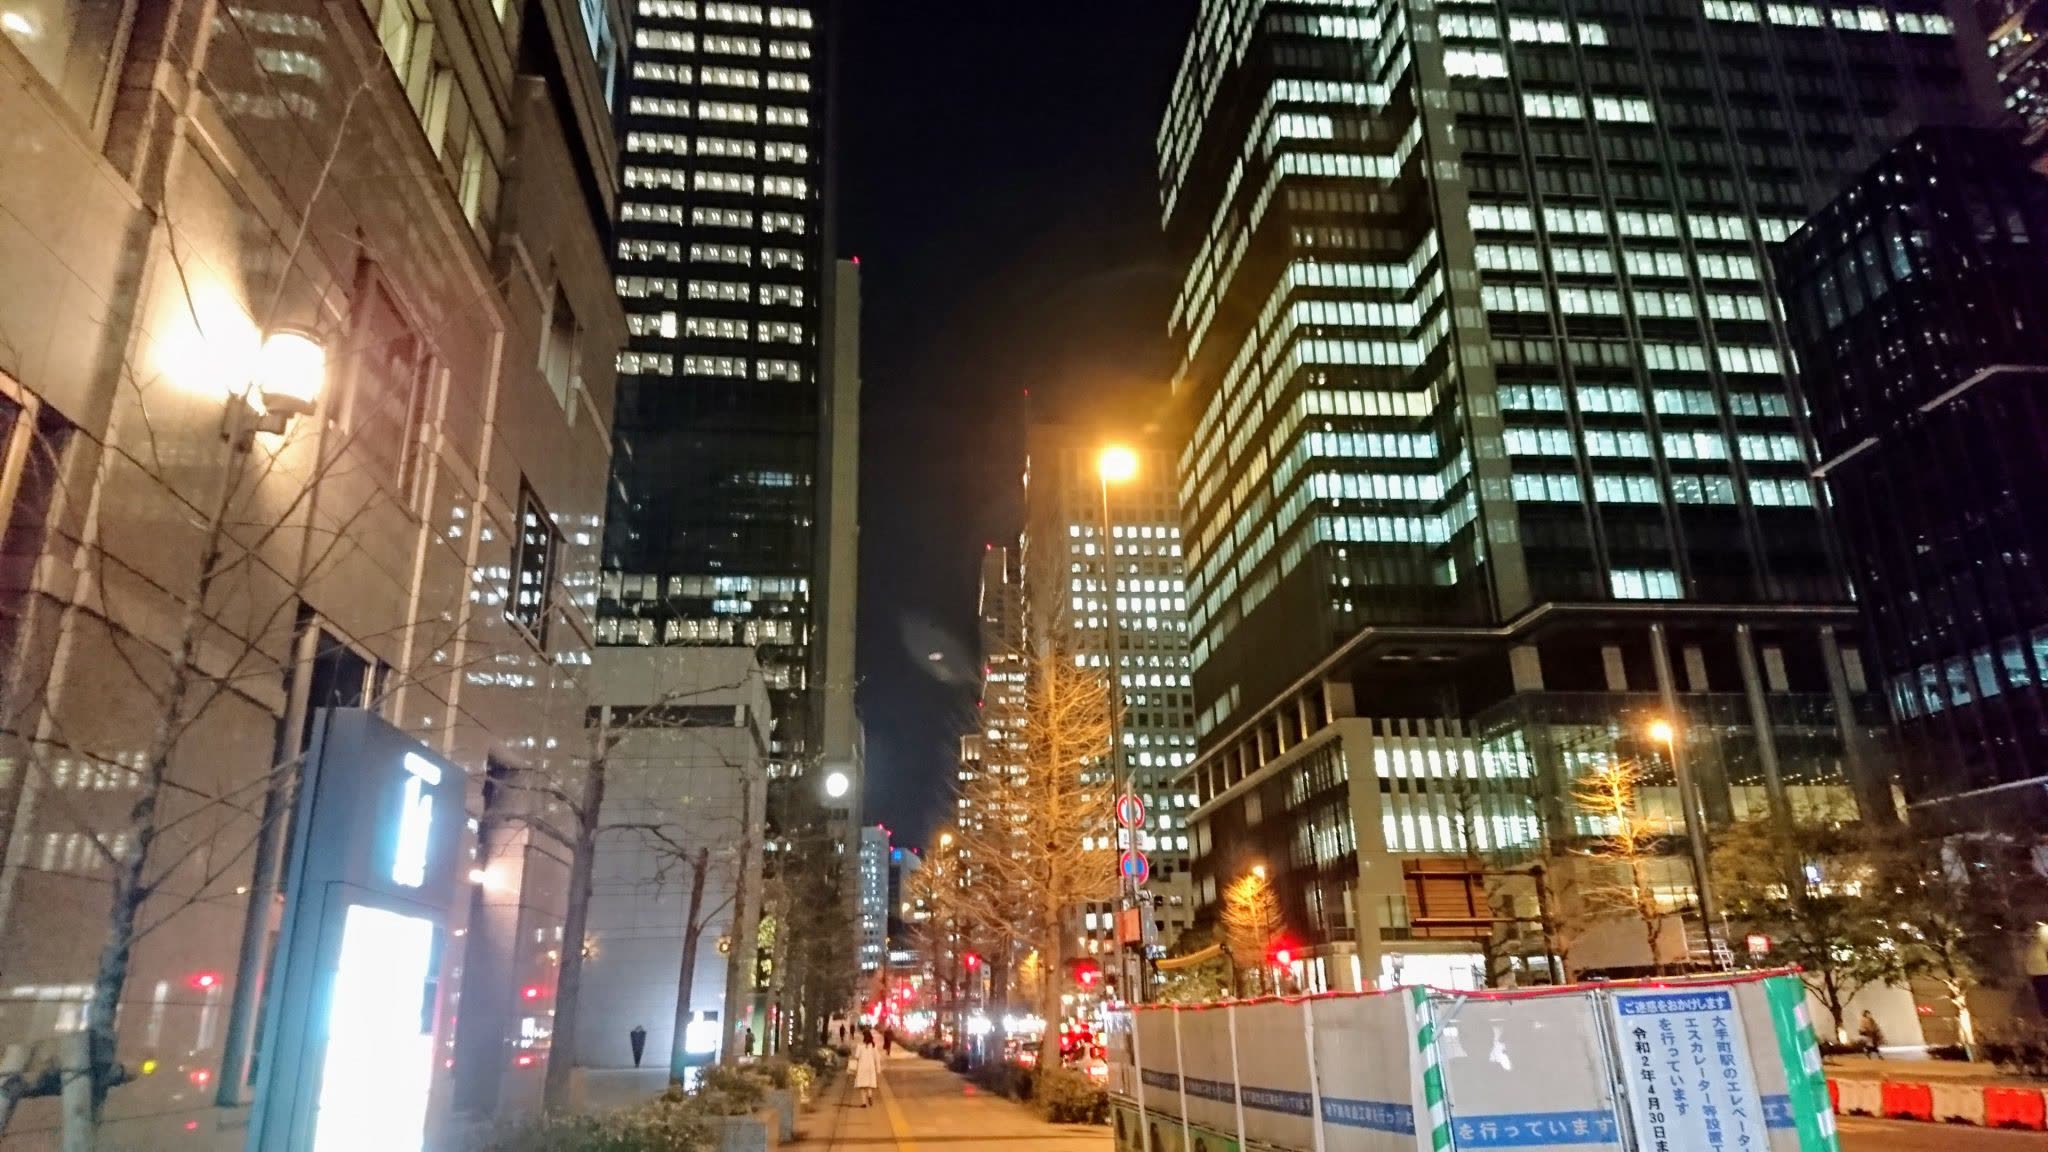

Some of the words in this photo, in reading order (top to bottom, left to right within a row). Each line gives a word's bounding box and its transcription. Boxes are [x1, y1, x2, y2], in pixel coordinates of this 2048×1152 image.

[1625, 997, 1726, 1014] ご迷惑をおかけします
[1658, 1017, 1689, 1116] を行っています
[1712, 1015, 1750, 1152] 大手町駅のエレベータ
[1458, 1117, 1613, 1141] を行っています
